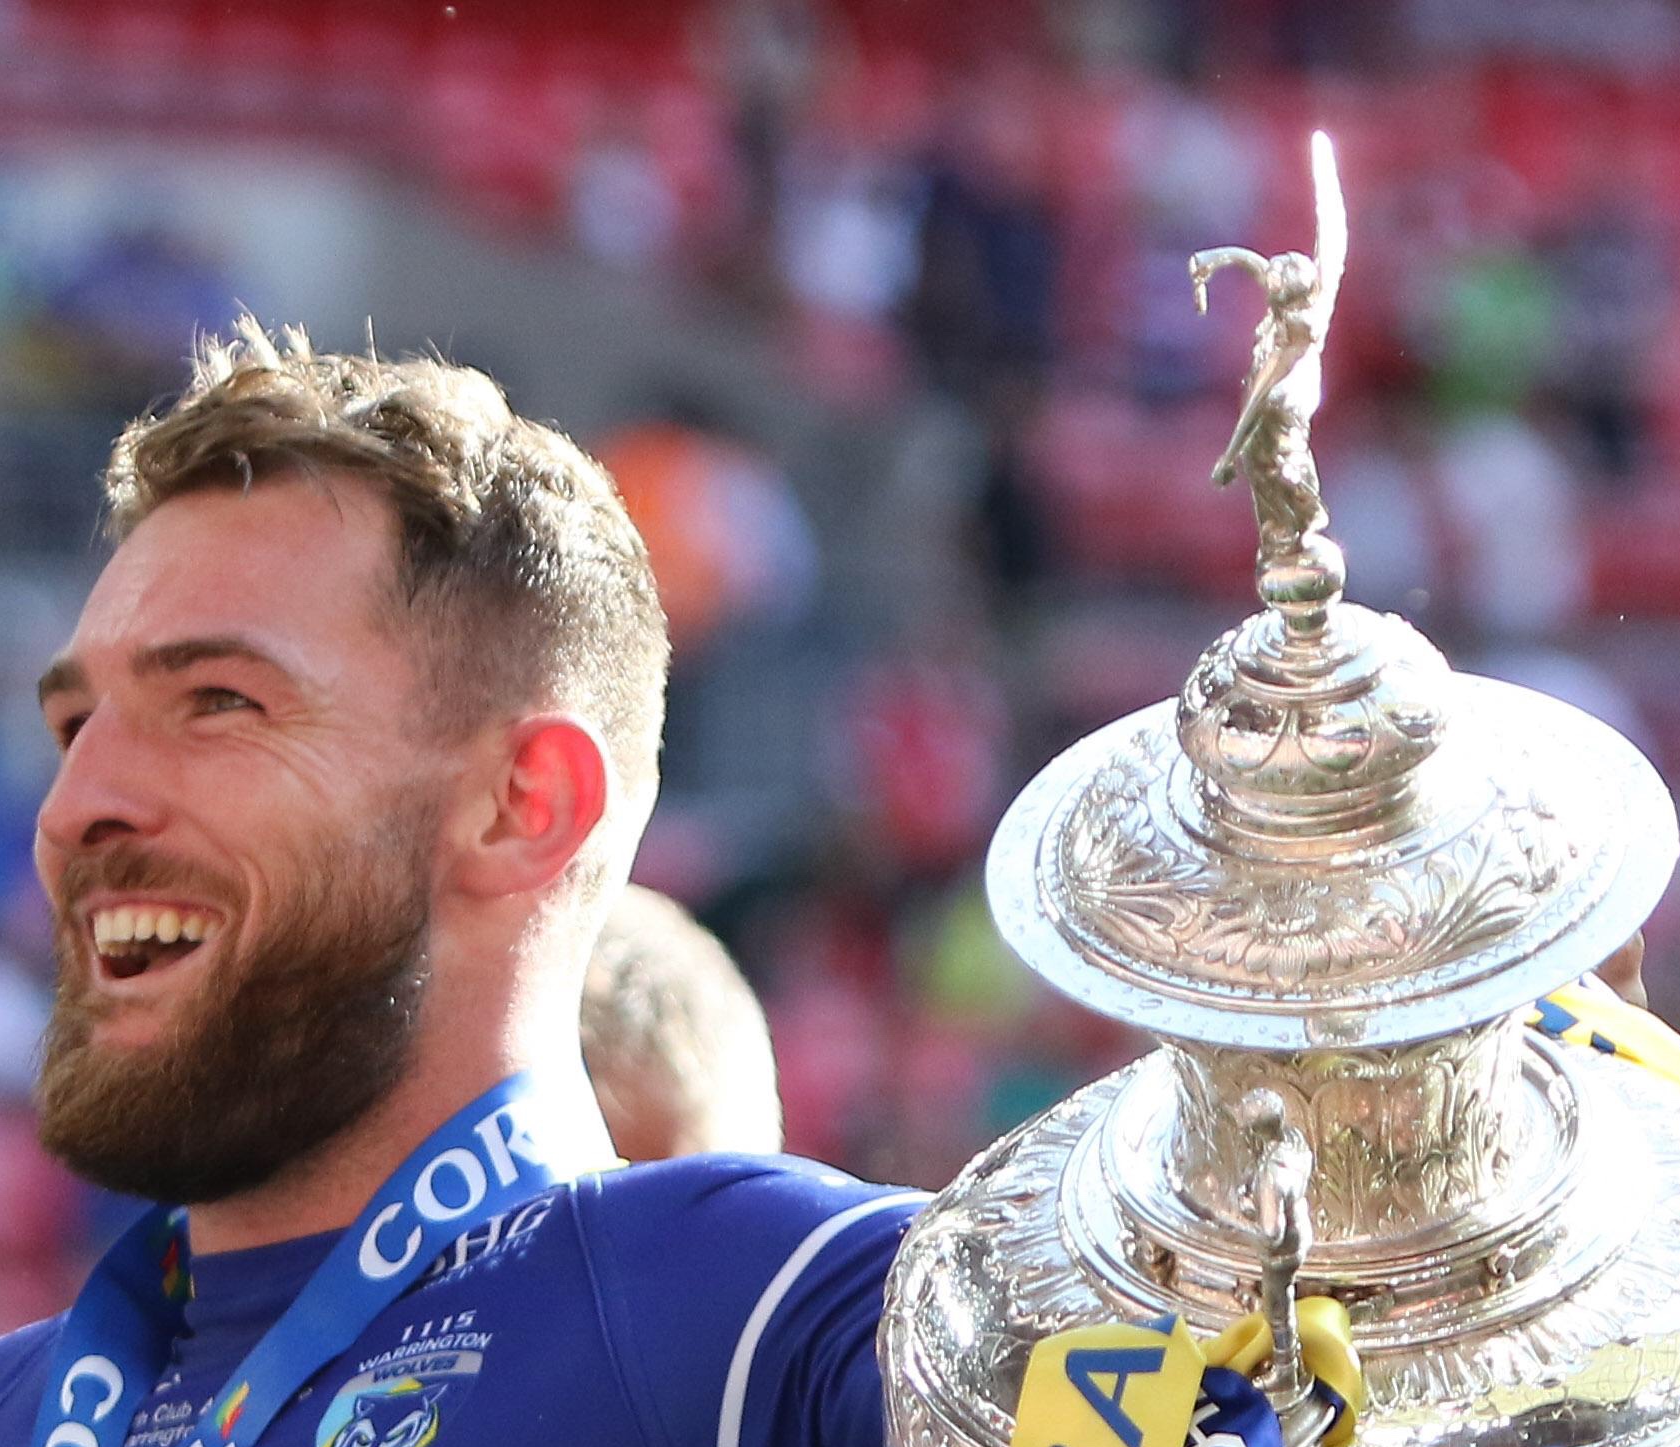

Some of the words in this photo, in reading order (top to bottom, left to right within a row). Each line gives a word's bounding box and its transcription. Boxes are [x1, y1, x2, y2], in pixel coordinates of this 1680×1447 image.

[431, 1196, 555, 1273] HG
[400, 1309, 477, 1342] 1115
[358, 1331, 494, 1373] WARRINGTON
[371, 1354, 460, 1384] WOLVES
